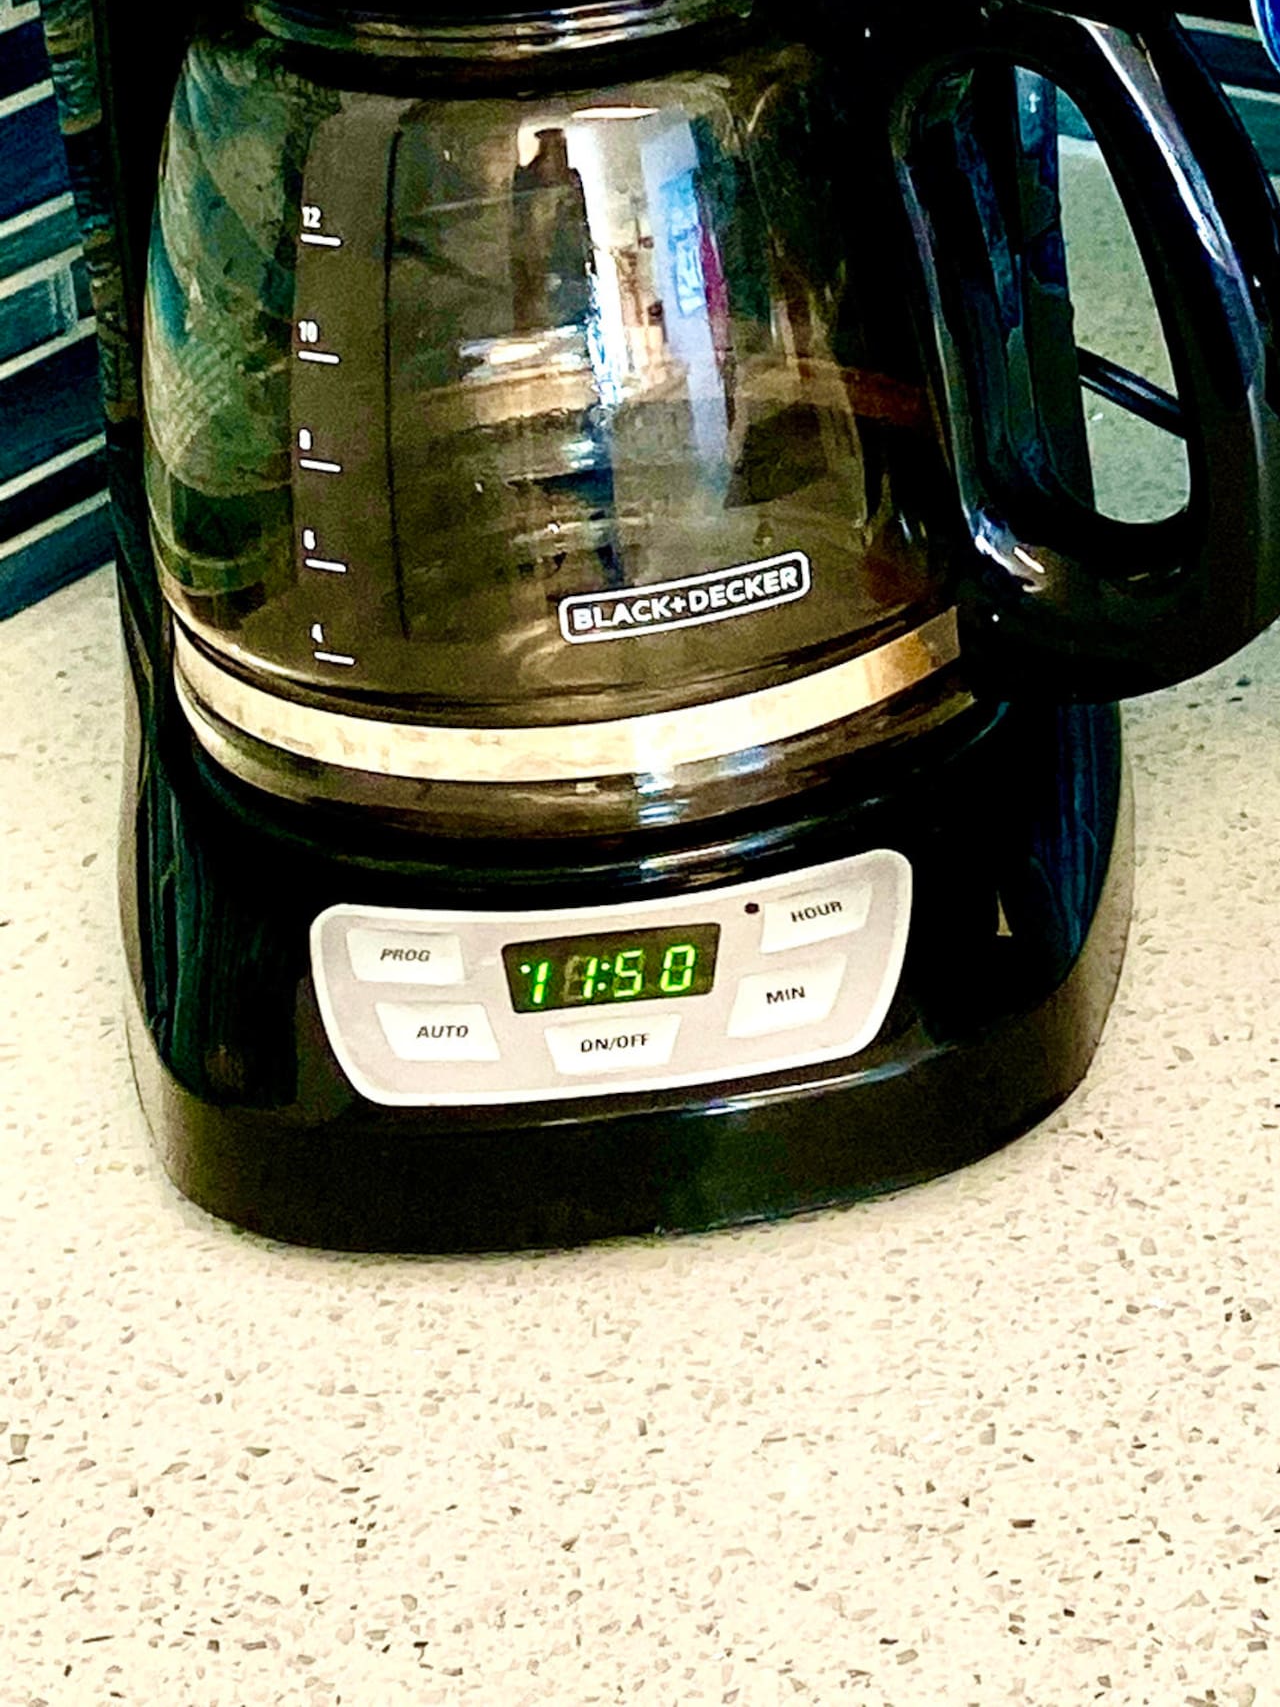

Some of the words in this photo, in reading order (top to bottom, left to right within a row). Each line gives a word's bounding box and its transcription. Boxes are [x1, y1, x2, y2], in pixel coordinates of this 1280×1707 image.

[301, 205, 322, 229] 12
[298, 321, 320, 343] 10
[572, 565, 799, 631] BLACK+DECKER
[789, 900, 844, 923] HOUR
[379, 947, 431, 964] PROG
[533, 945, 697, 1004] 11:50
[765, 984, 807, 1005] MIN
[416, 1023, 470, 1041] AUTO
[580, 1032, 651, 1055] ON/OFF
